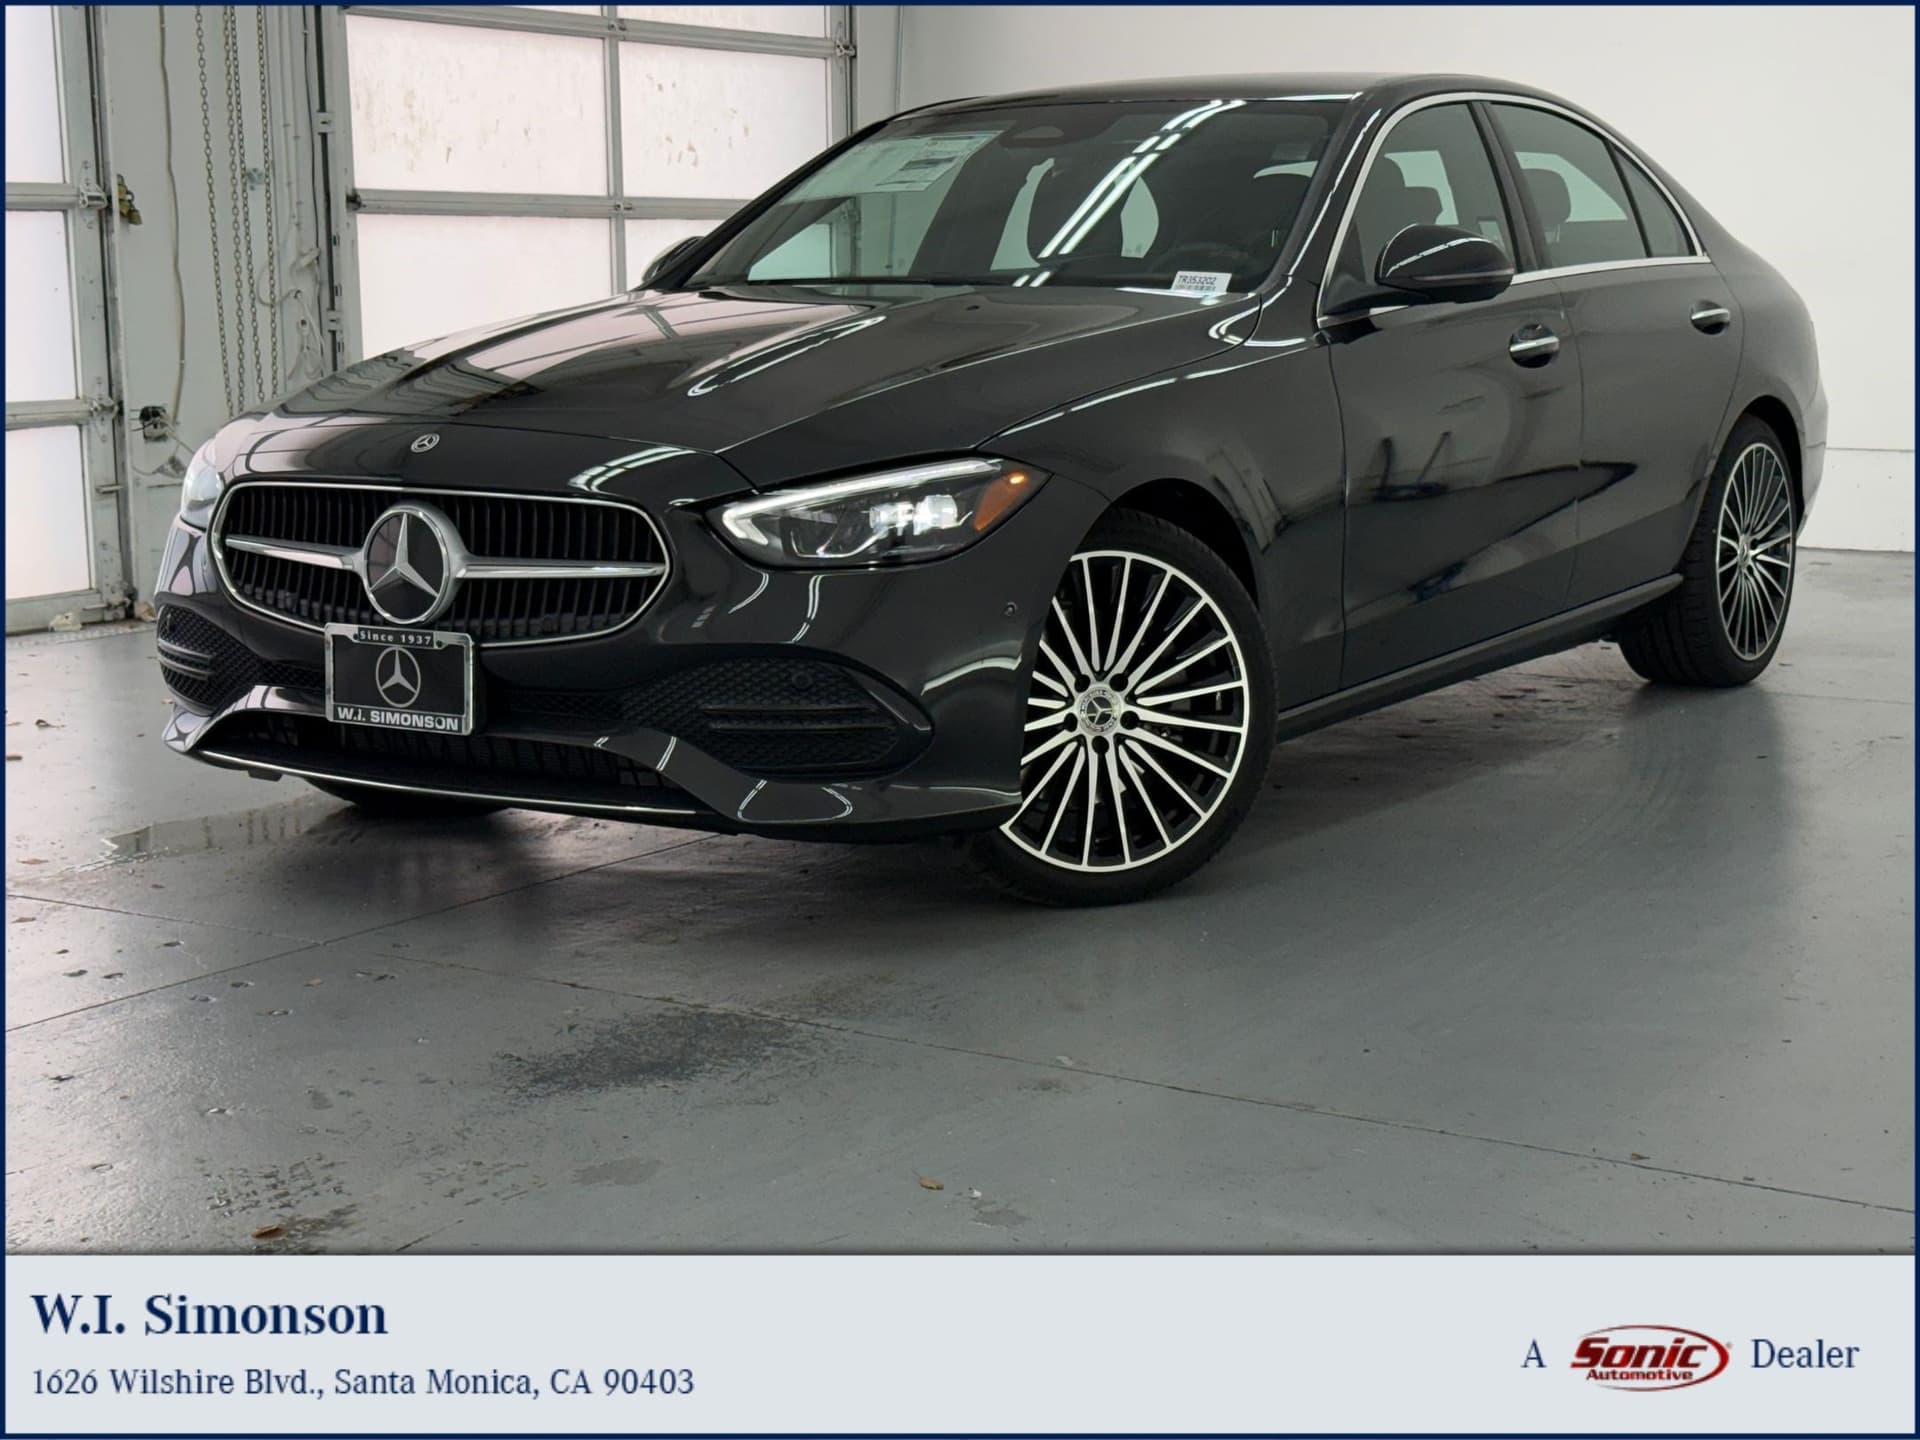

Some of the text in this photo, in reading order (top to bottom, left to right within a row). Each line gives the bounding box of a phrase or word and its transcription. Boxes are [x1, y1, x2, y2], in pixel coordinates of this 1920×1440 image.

[359, 630, 432, 646] Since 1937
[338, 706, 459, 731] W.I. SIMONSON
